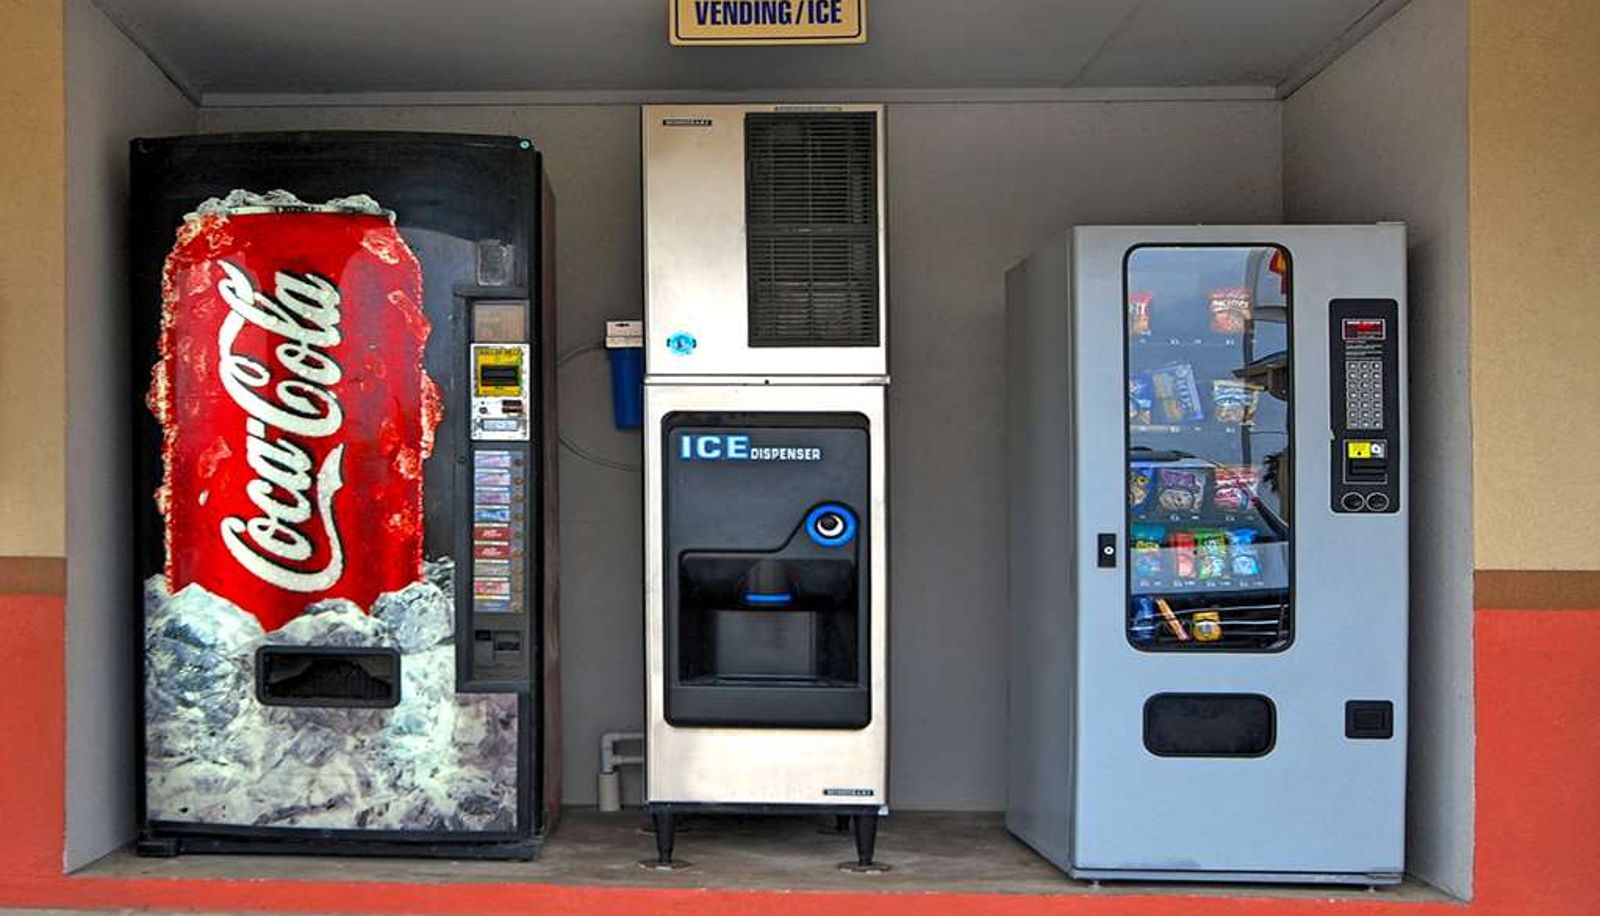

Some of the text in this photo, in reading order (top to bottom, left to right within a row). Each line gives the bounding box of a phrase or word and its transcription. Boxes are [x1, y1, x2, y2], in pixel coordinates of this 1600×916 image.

[694, 0, 842, 25] VENDING/ICE
[217, 258, 345, 593] Coca-Cola
[680, 435, 821, 461] ICE DISPENSER
